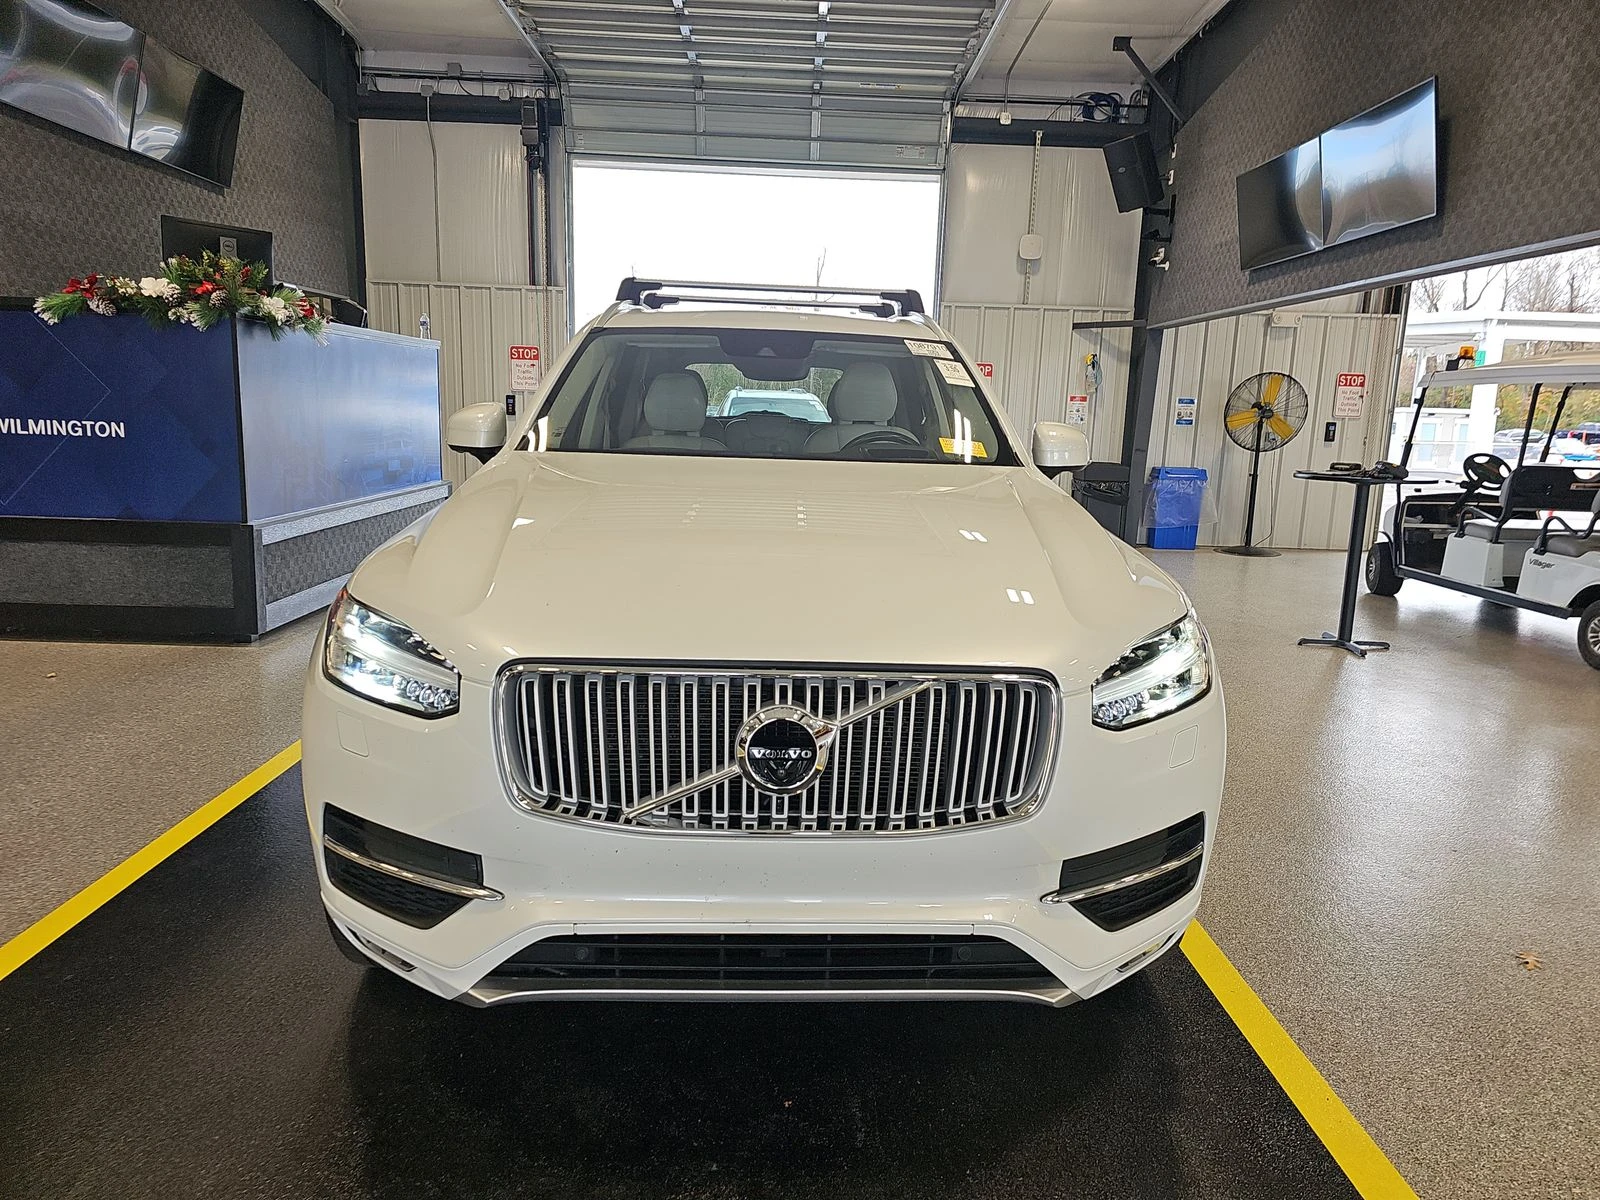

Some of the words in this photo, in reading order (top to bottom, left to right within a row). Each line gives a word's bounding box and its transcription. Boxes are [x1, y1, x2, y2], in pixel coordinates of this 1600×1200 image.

[511, 348, 538, 359] STOP
[978, 365, 992, 376] OP
[1339, 375, 1364, 386] STOP
[751, 749, 812, 758] VOLVO
